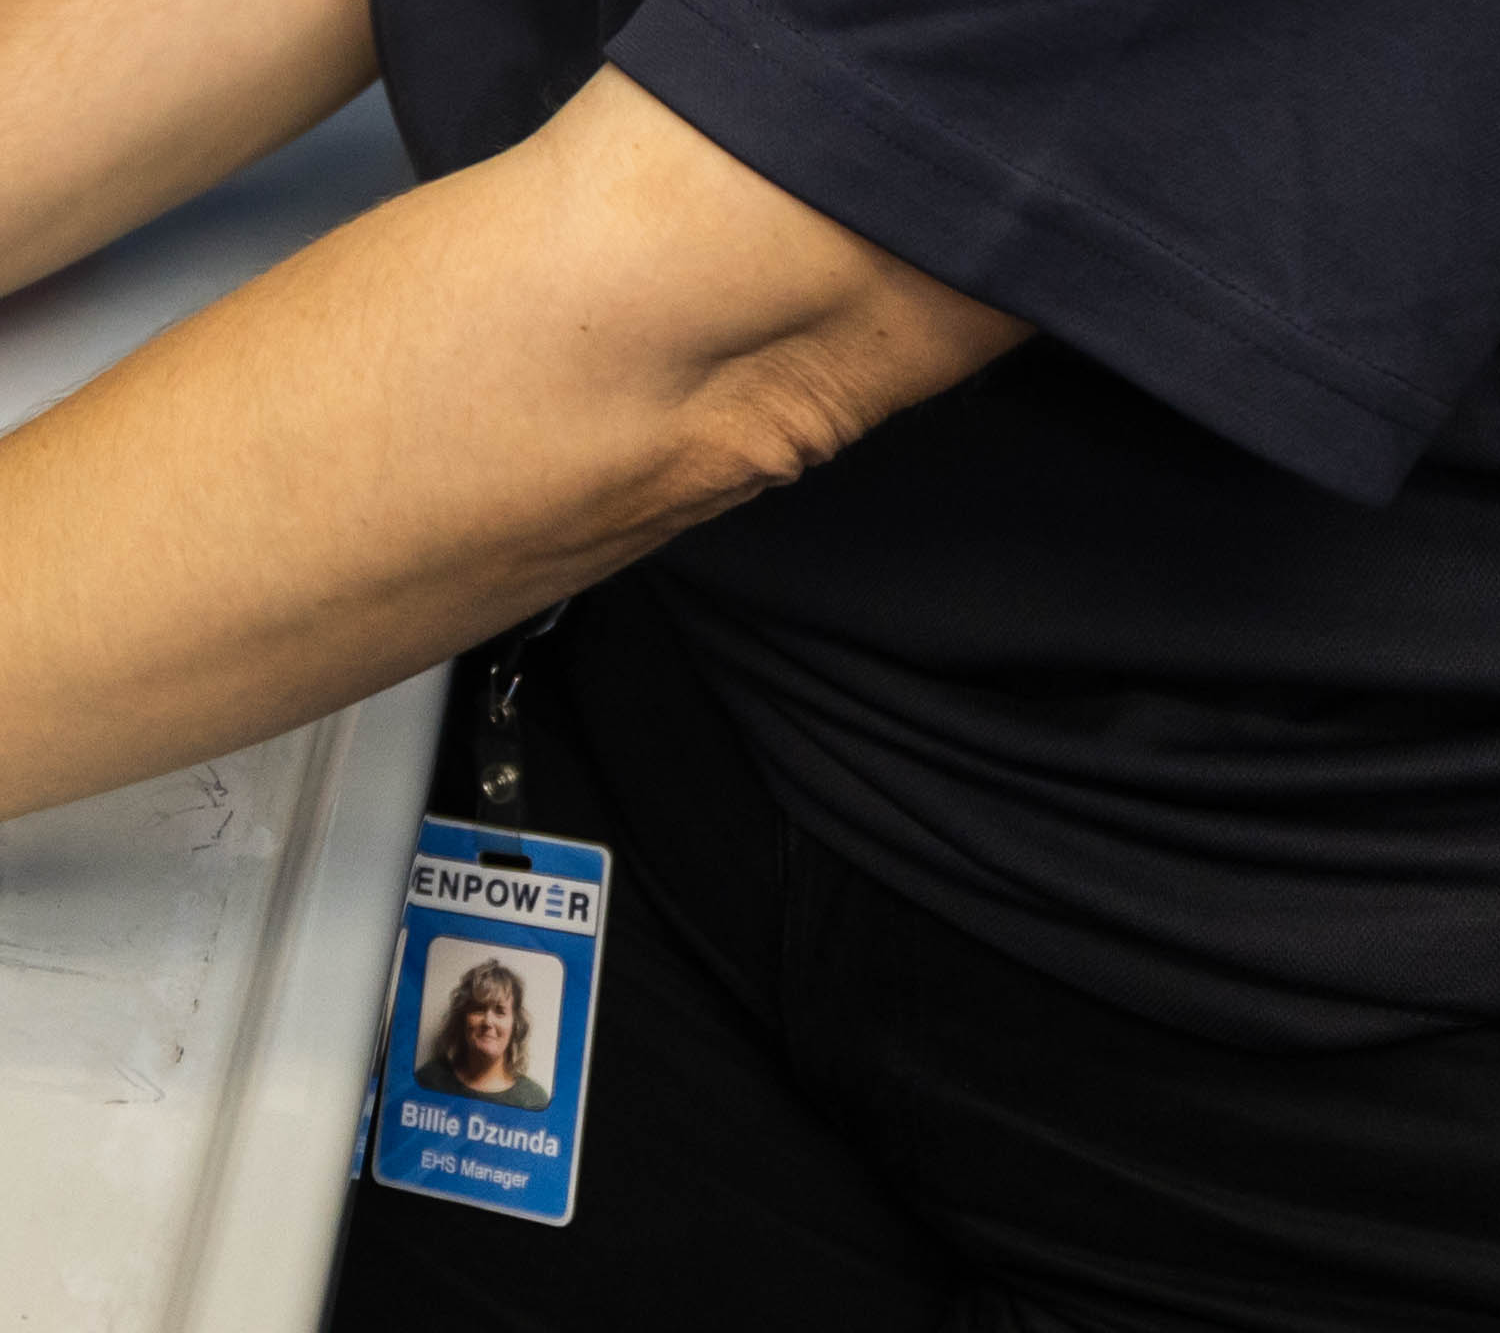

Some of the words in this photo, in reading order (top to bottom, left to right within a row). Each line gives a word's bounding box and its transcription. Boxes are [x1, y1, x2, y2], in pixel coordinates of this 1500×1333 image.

[415, 865, 590, 922] ENPOWER
[400, 1102, 460, 1137] Billie
[467, 1115, 560, 1159] Dzunda
[421, 1150, 456, 1176] EHS
[460, 1160, 530, 1191] Manager
